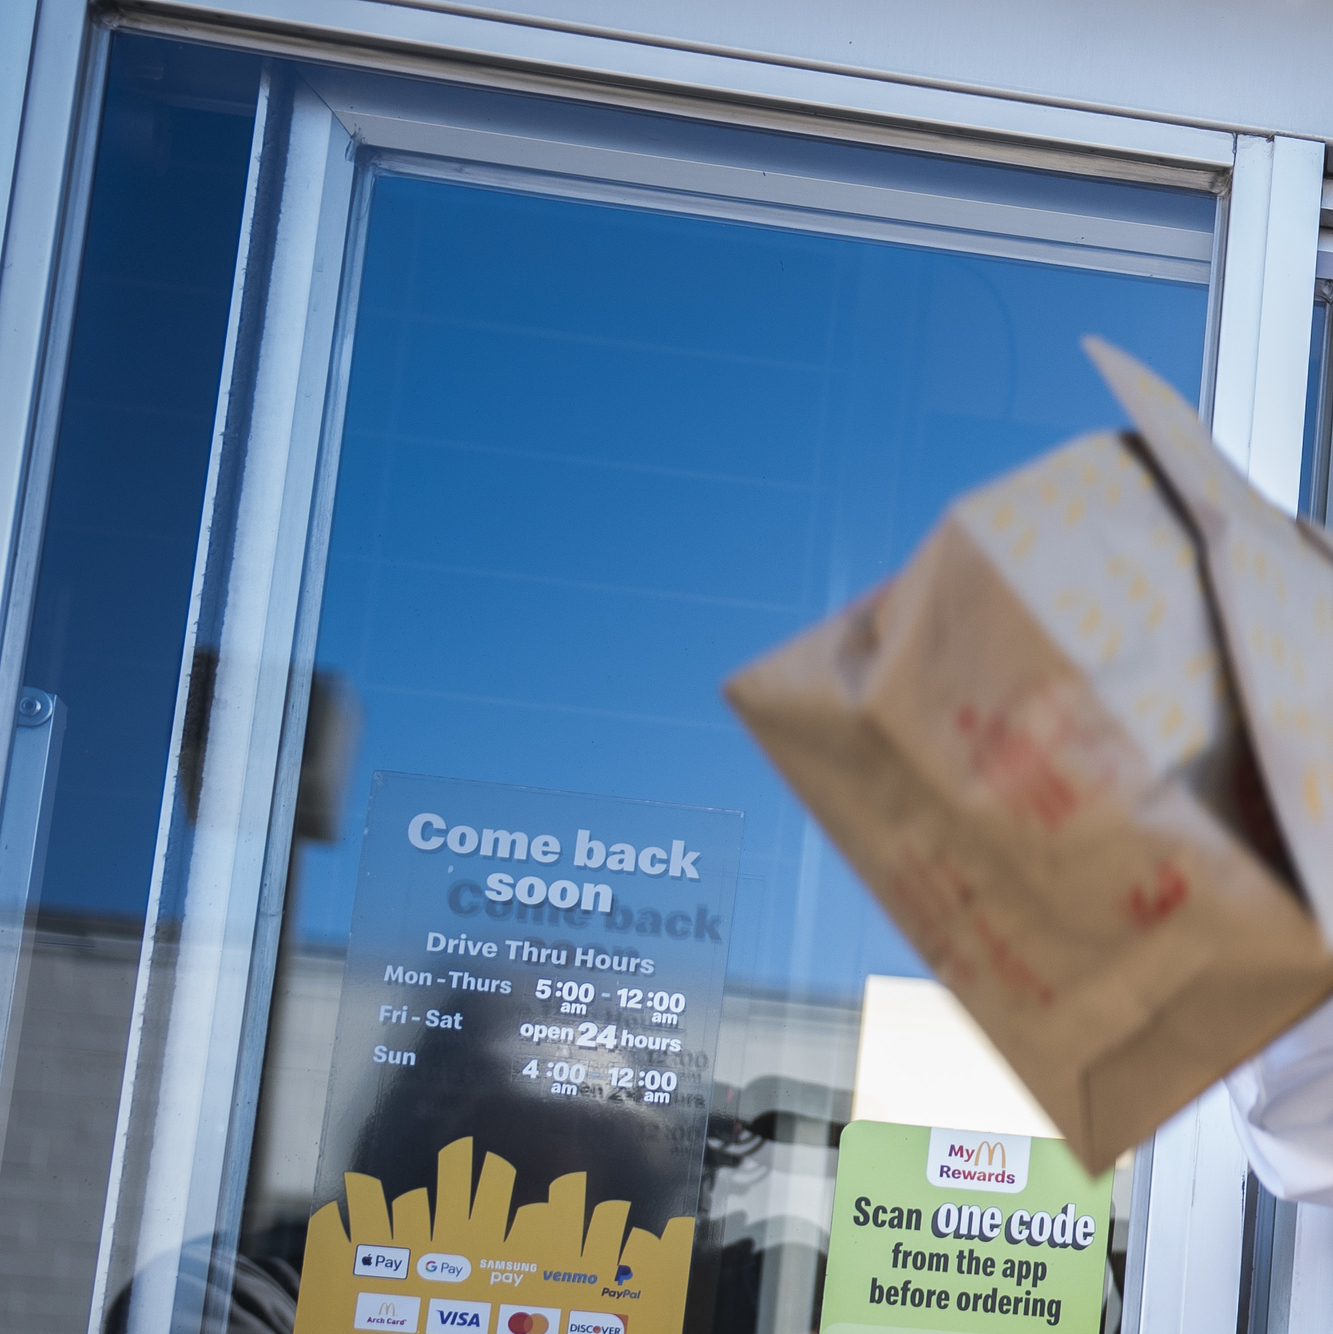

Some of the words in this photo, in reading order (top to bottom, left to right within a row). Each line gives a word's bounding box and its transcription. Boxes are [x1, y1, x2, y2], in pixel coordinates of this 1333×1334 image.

[407, 813, 561, 863] Come
[573, 829, 702, 879] back
[484, 872, 613, 913] soon
[426, 932, 498, 958] Drive
[505, 939, 567, 966] Thru
[574, 947, 655, 975] Hours
[535, 978, 595, 1004] 5:00
[616, 988, 686, 1012] 12:00
[379, 1005, 407, 1024] Fri
[425, 1008, 463, 1030] Sat
[520, 1022, 574, 1042] open
[576, 1022, 618, 1049] 24
[620, 1030, 682, 1052] hours
[560, 1002, 587, 1015] am
[651, 1012, 678, 1025] am
[373, 1046, 416, 1066] Sun
[609, 1067, 678, 1092] 12:00
[550, 1082, 578, 1096] am
[643, 1090, 670, 1104] am
[948, 1144, 975, 1162] My
[939, 1164, 1016, 1185] Rewards
[852, 1196, 922, 1231] Scan
[934, 1202, 1002, 1241] one
[1007, 1203, 1096, 1250] code
[376, 1255, 402, 1271] Pay
[440, 1262, 463, 1278] Pay
[480, 1259, 538, 1273] SAMSUNG
[543, 1270, 598, 1285] venmo
[490, 1272, 524, 1286] pay
[892, 1242, 949, 1272] from
[956, 1248, 996, 1278] the
[1002, 1258, 1048, 1288] app
[601, 1287, 642, 1299] PayPal
[869, 1277, 949, 1310] before
[957, 1288, 1062, 1326] ordering
[367, 1316, 385, 1324] Arch
[436, 1310, 480, 1328] VISA
